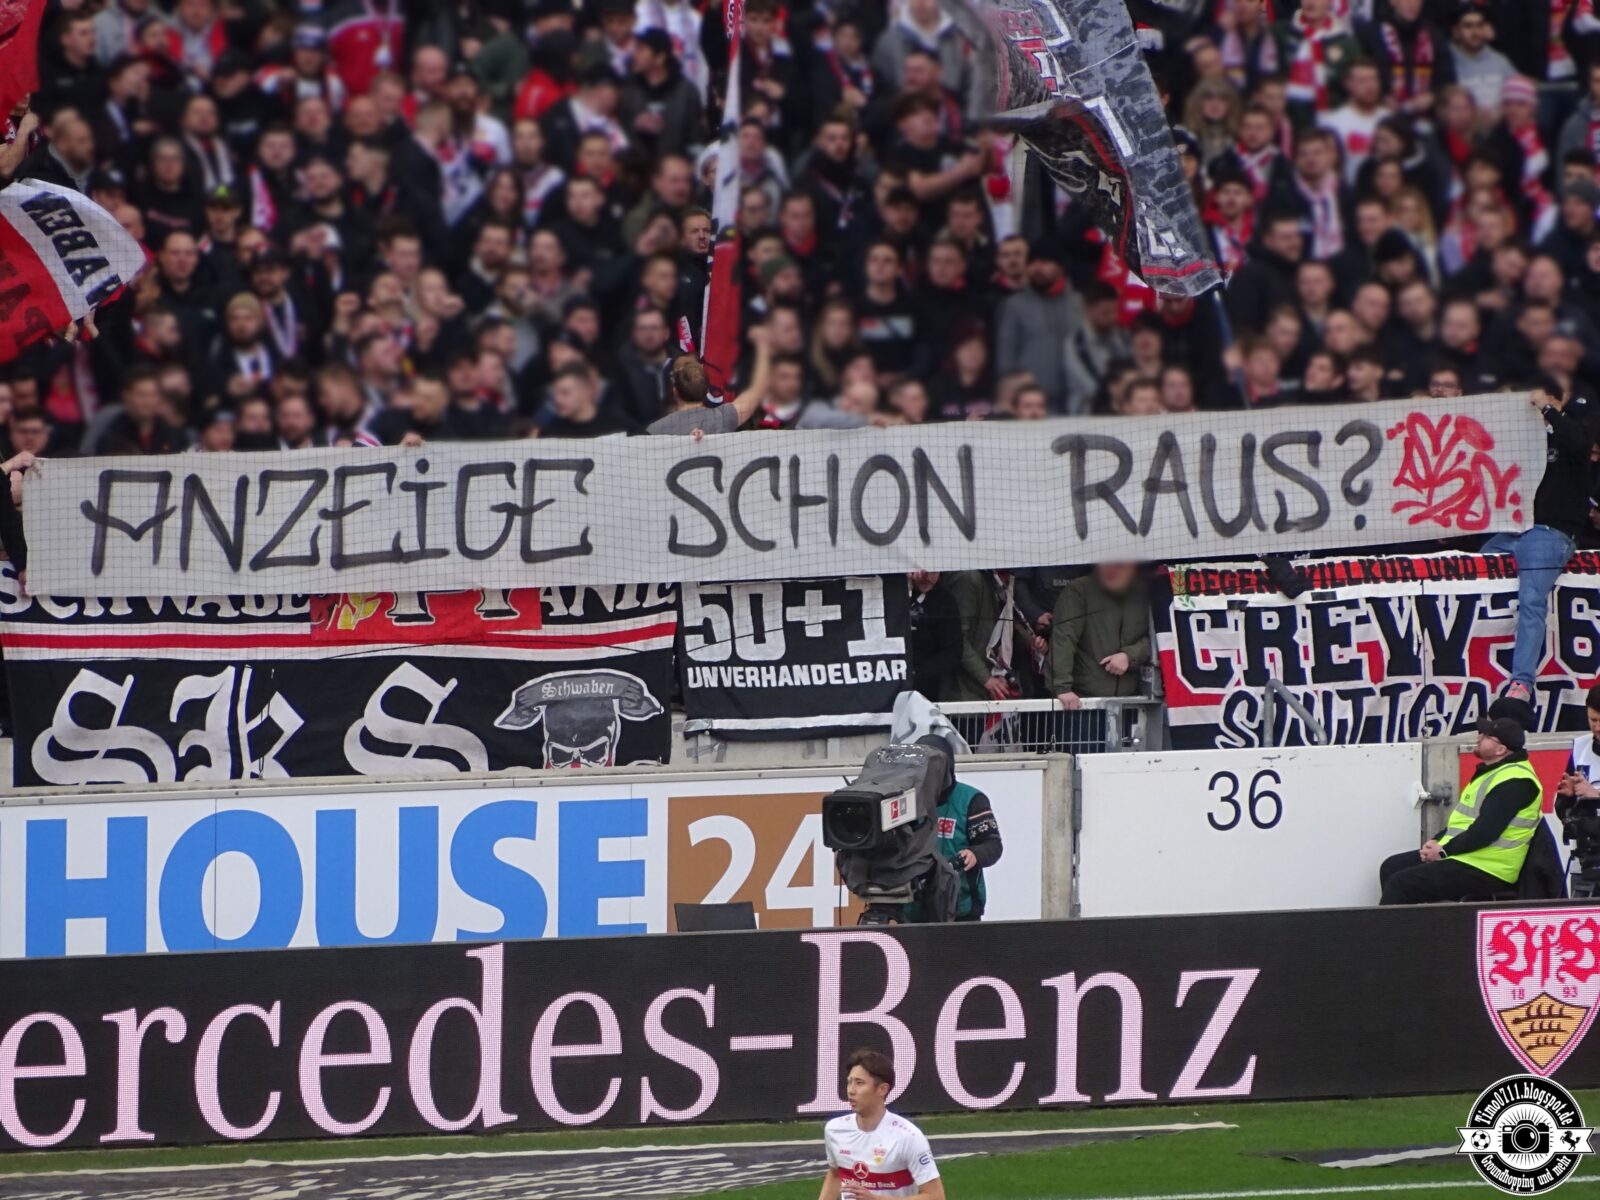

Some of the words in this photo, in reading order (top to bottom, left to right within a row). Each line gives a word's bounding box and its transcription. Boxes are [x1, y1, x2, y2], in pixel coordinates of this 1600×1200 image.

[665, 444, 977, 558] SCHON
[1051, 419, 1383, 541] RAUS?
[1423, 554, 1478, 583] UND
[681, 575, 906, 662] 50+1
[1176, 592, 1482, 688] CREW
[541, 679, 615, 699] Schwaben
[687, 659, 907, 689] UNVERHANDELBAR
[1207, 769, 1283, 831] 36
[26, 798, 649, 957] HOUSE
[688, 813, 849, 928] 24
